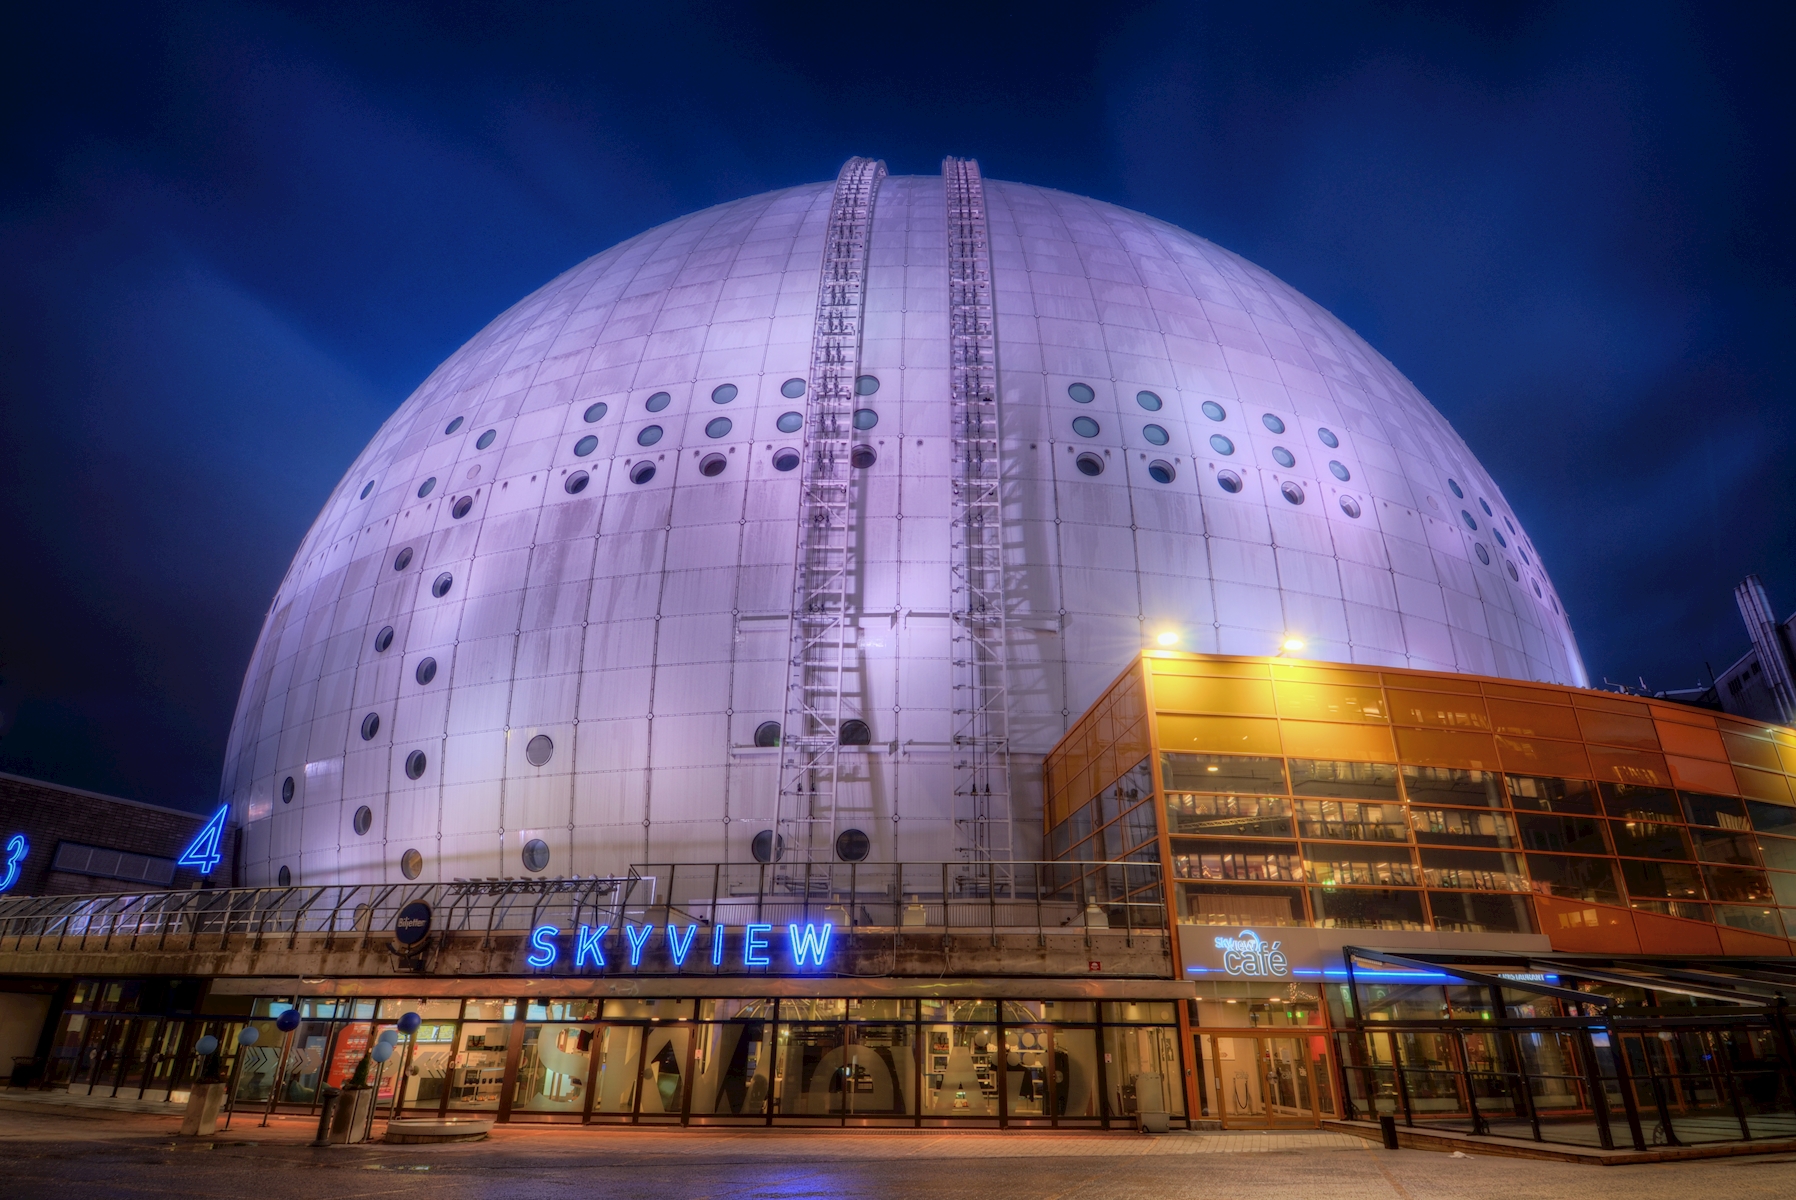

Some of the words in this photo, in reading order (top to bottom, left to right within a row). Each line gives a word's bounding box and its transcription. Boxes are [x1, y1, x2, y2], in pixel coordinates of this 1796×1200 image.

[177, 803, 229, 874] 4
[0, 834, 28, 892] 3
[398, 916, 426, 930] Biljetter
[528, 923, 832, 967] SKYVIEW
[1223, 941, 1288, 976] café
